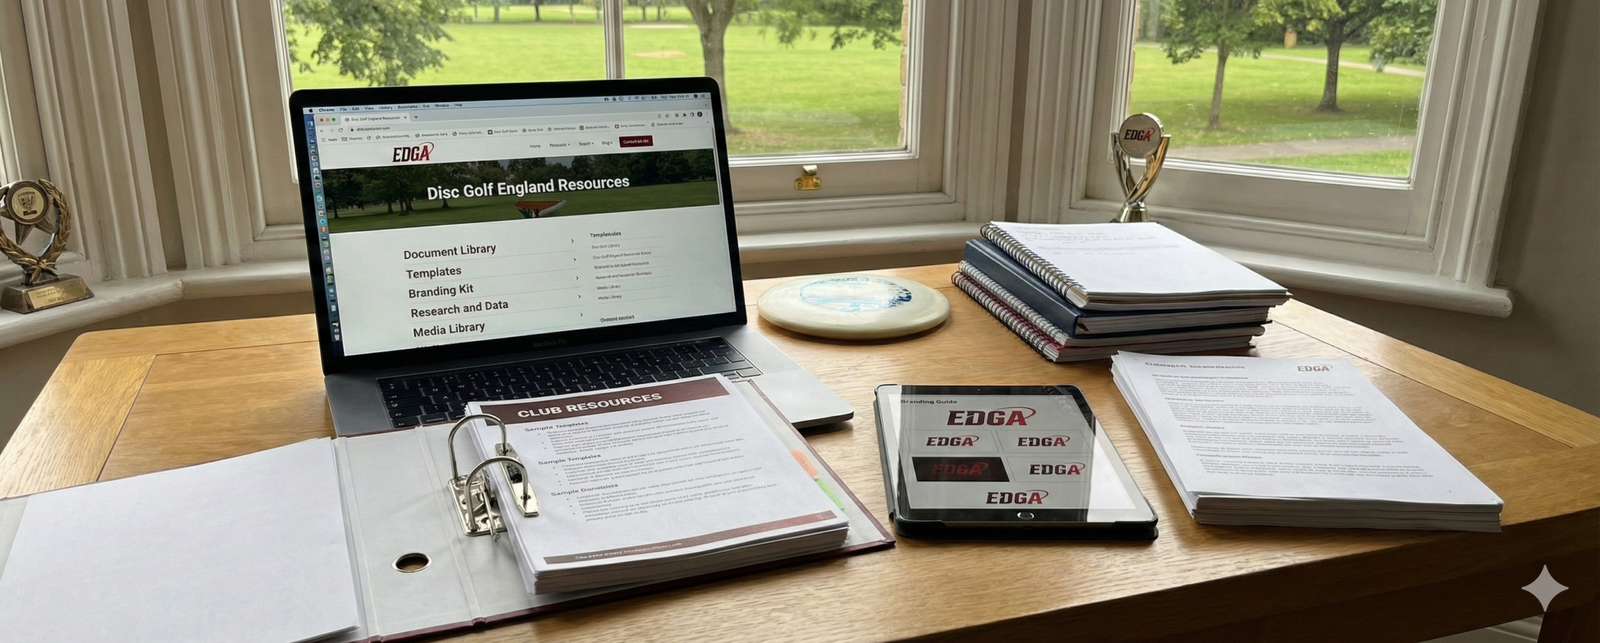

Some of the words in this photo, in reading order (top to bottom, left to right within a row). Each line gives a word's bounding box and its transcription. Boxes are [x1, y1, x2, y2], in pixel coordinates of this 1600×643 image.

[1124, 128, 1154, 142] EDGA
[392, 143, 433, 162] EDGA
[427, 186, 460, 200] Disc
[463, 182, 494, 197] Golf
[498, 178, 554, 197] England
[558, 176, 630, 192] Resources
[404, 246, 458, 260] Document
[460, 244, 497, 256] Library
[406, 267, 462, 280] Templates
[408, 286, 456, 298] Branding
[459, 284, 474, 294] Kit
[410, 304, 460, 318] Research
[463, 302, 482, 312] and
[485, 300, 509, 310] Data
[413, 325, 446, 338] Media
[449, 322, 486, 334] Library
[1297, 364, 1332, 372] EDGA
[518, 406, 562, 418] CLUB
[566, 393, 662, 412] RESOURCES
[947, 407, 1034, 426] EDGA
[926, 436, 978, 446] EDGA
[1018, 436, 1069, 446] EDGA
[931, 462, 988, 475] EDGA
[1029, 462, 1084, 475] EDGA
[550, 488, 580, 496] Sample
[986, 490, 1048, 504] EDGA
